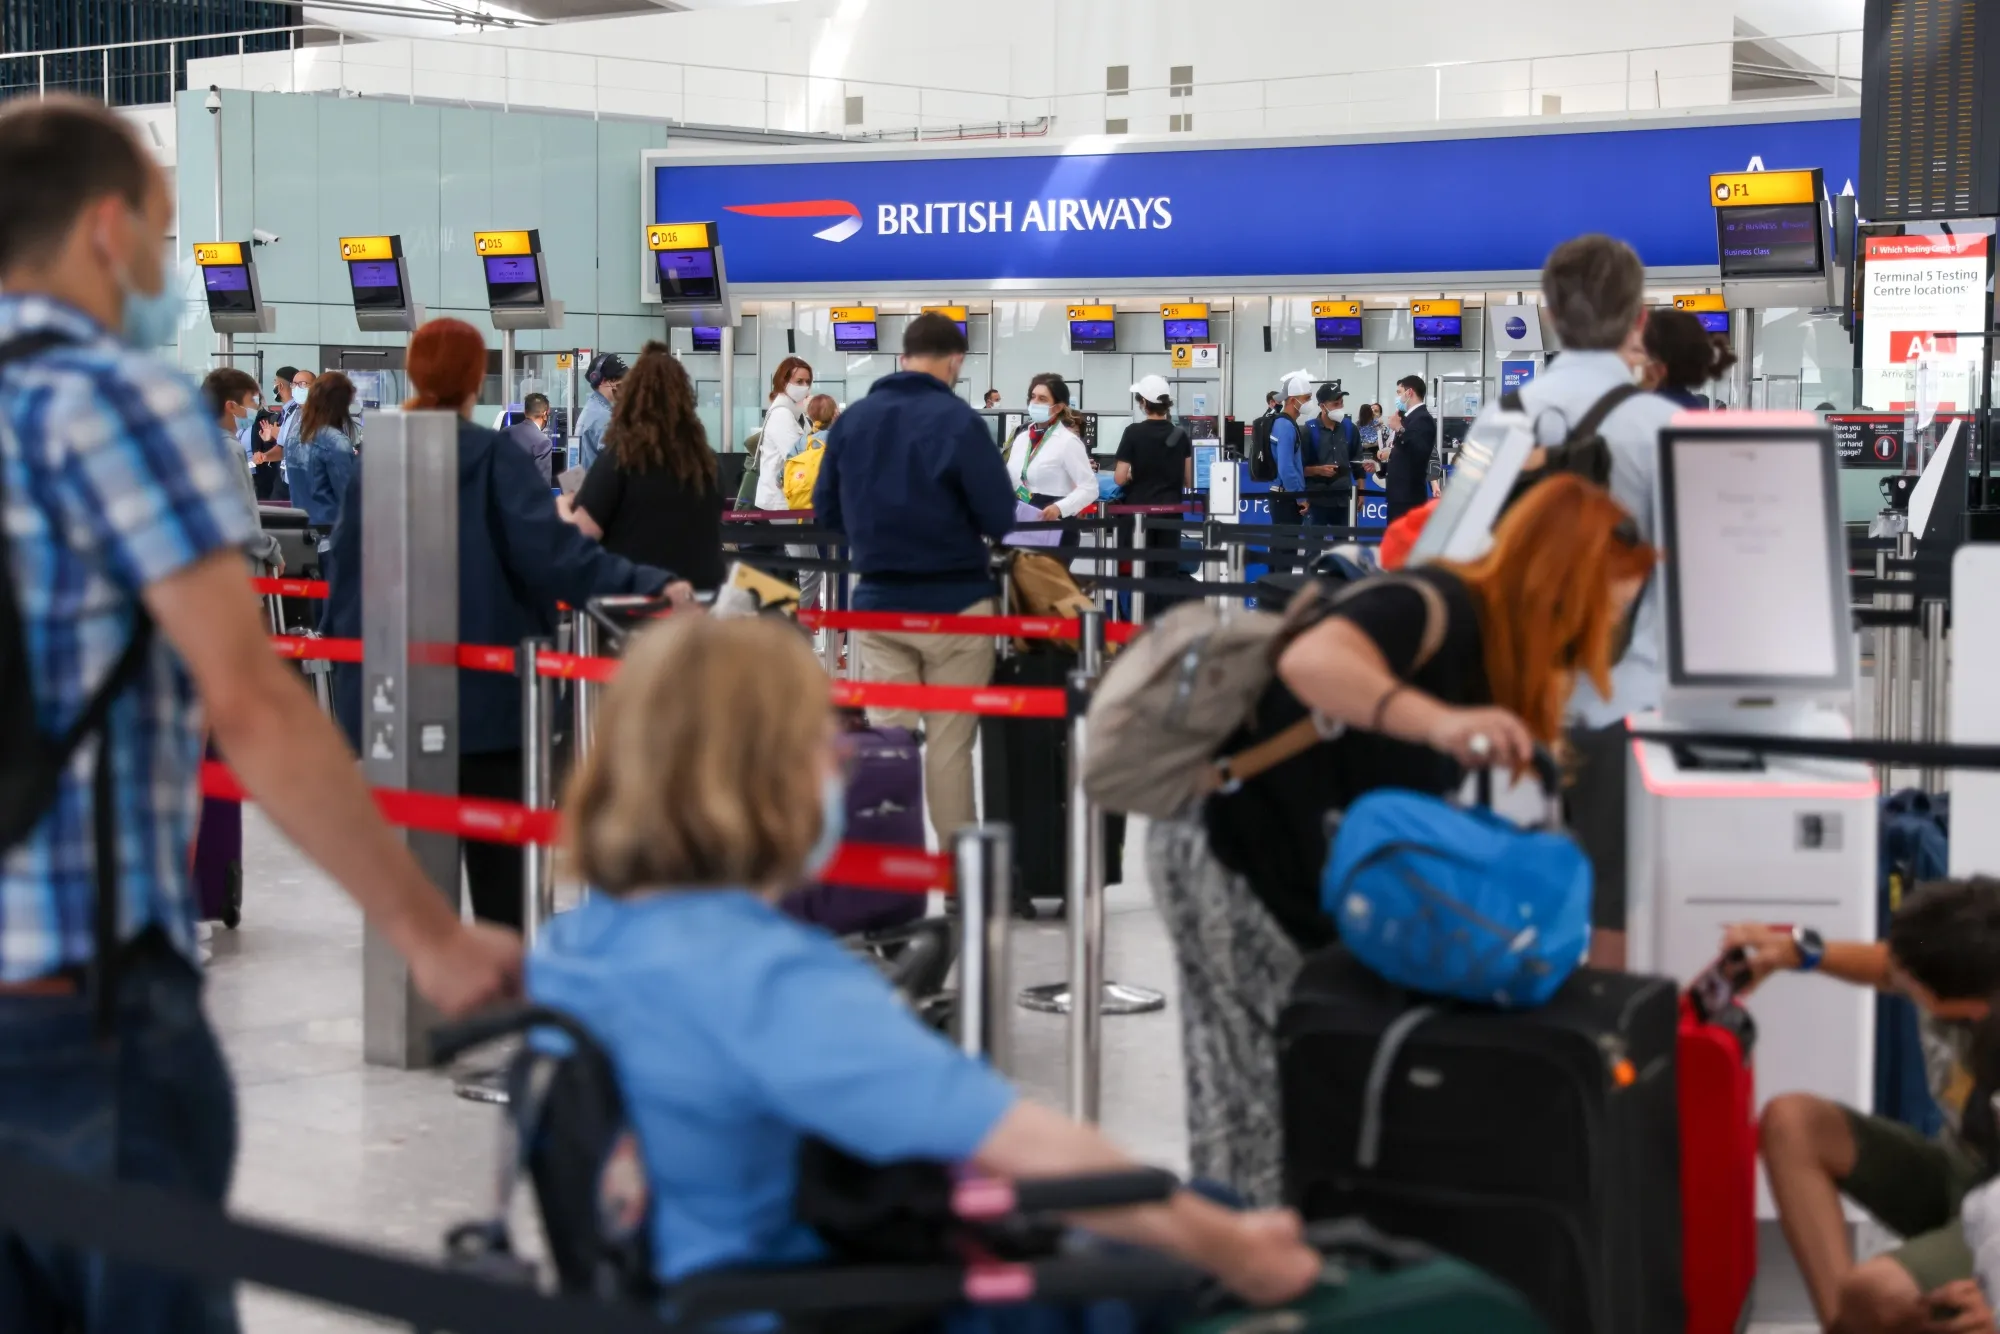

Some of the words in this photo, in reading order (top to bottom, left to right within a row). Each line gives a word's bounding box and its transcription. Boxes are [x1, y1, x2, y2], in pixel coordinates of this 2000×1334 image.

[1733, 184, 1749, 197] F1
[877, 201, 1012, 235] BRITISH
[1020, 197, 1172, 232] AIRWAYS
[661, 232, 678, 243] D16
[352, 244, 366, 254] D14
[487, 238, 503, 249] D15
[205, 249, 218, 259] D13
[1724, 247, 1753, 256] Business
[1753, 247, 1770, 255] Class
[1880, 245, 1903, 254] Which
[1904, 245, 1930, 254] Testing
[1874, 271, 1923, 283] Terminal
[1926, 270, 1933, 281] 5
[1936, 269, 1978, 282] Testing
[1873, 285, 1911, 297] Centre
[1906, 336, 1937, 359] A1
[1847, 440, 1863, 448] hand
